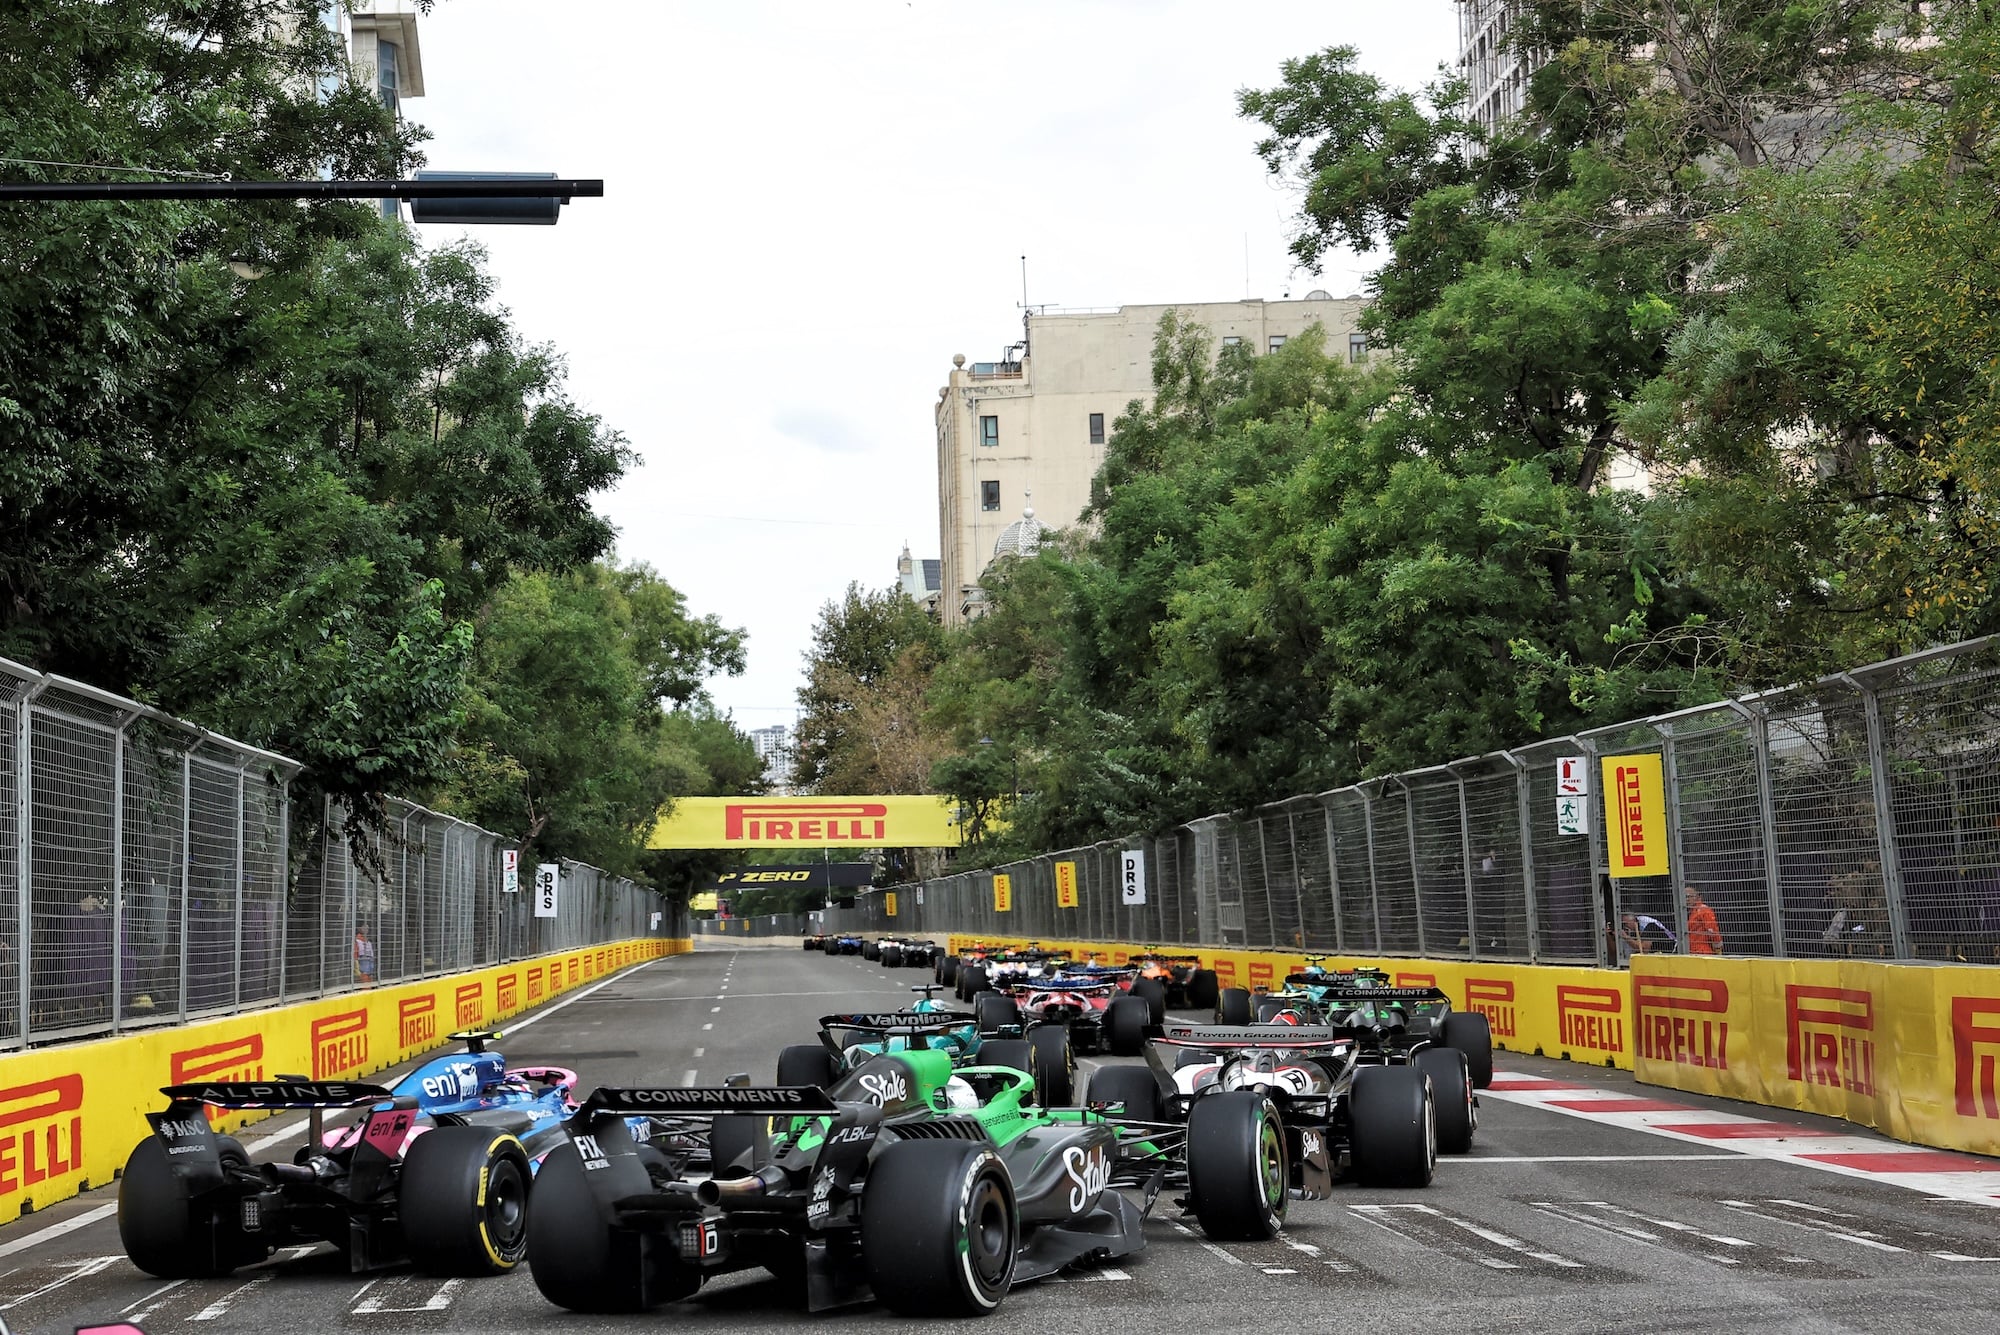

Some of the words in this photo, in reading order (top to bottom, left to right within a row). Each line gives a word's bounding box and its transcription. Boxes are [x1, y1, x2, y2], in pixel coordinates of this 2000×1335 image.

[725, 803, 888, 840] PIRELLI
[1616, 766, 1646, 868] PIRELLI
[543, 871, 553, 909] DRS
[740, 870, 811, 883] ZERO
[1126, 859, 1136, 896] DRS
[1318, 973, 1374, 982] Valvoli
[1345, 988, 1429, 996] COINPAYMENTS
[399, 994, 436, 1049] PIRELLI
[455, 982, 483, 1029] PIRELLI
[867, 1014, 952, 1026] Valvoline
[1465, 978, 1516, 1038] PELLI
[1557, 985, 1624, 1053] PIRELLI
[1634, 975, 1729, 1070] PIRELLI
[311, 1008, 368, 1081] PIRELLI
[1785, 984, 1876, 1098] PIRELLI
[201, 1085, 350, 1098] ALPINE
[422, 1066, 457, 1098] eni
[635, 1090, 802, 1103] COINPAYMENTS
[858, 1069, 908, 1110] Stake
[0, 1073, 84, 1196] ELLI
[171, 1120, 206, 1136] MSC
[370, 1116, 395, 1137] eni
[573, 1135, 605, 1160] FIX
[1062, 1145, 1111, 1213] Stake
